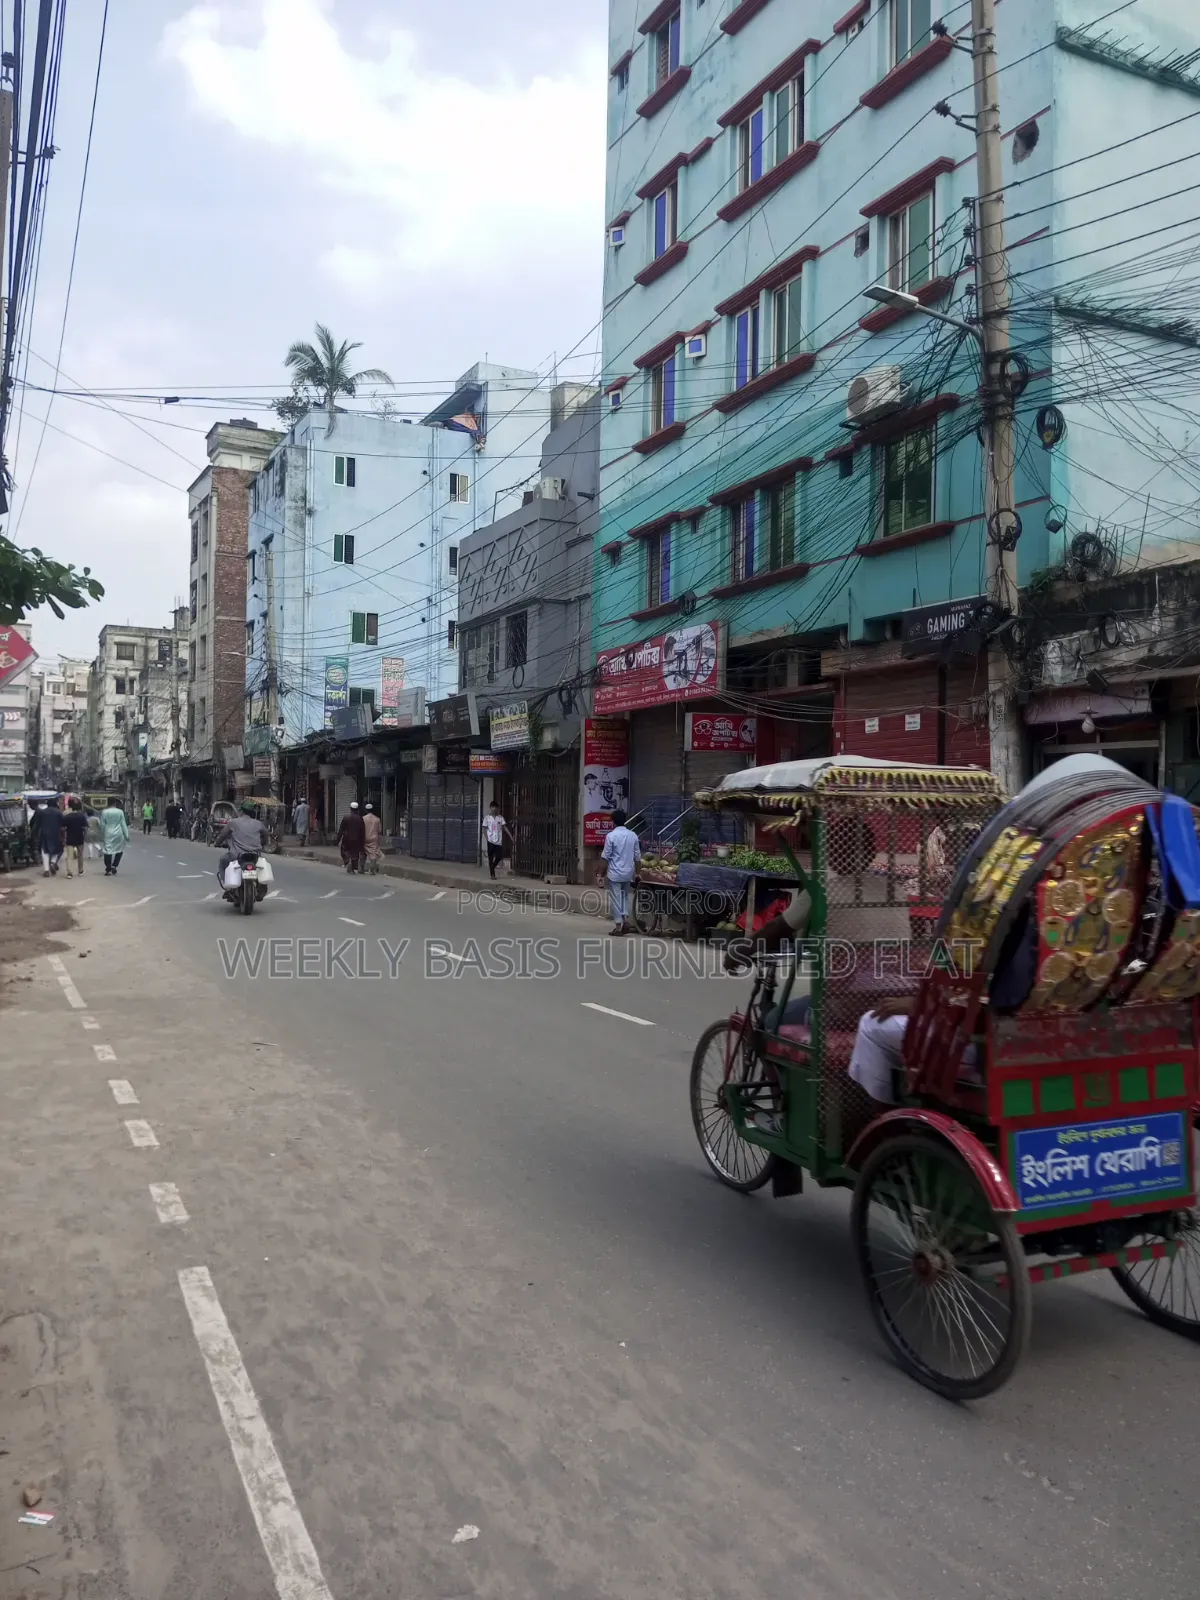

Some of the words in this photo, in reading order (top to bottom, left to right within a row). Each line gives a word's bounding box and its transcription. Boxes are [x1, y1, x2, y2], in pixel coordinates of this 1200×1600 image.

[927, 612, 965, 634] GAMING
[1020, 1148, 1090, 1188] ইংলিশ
[1095, 1136, 1161, 1176] থেরাপি
